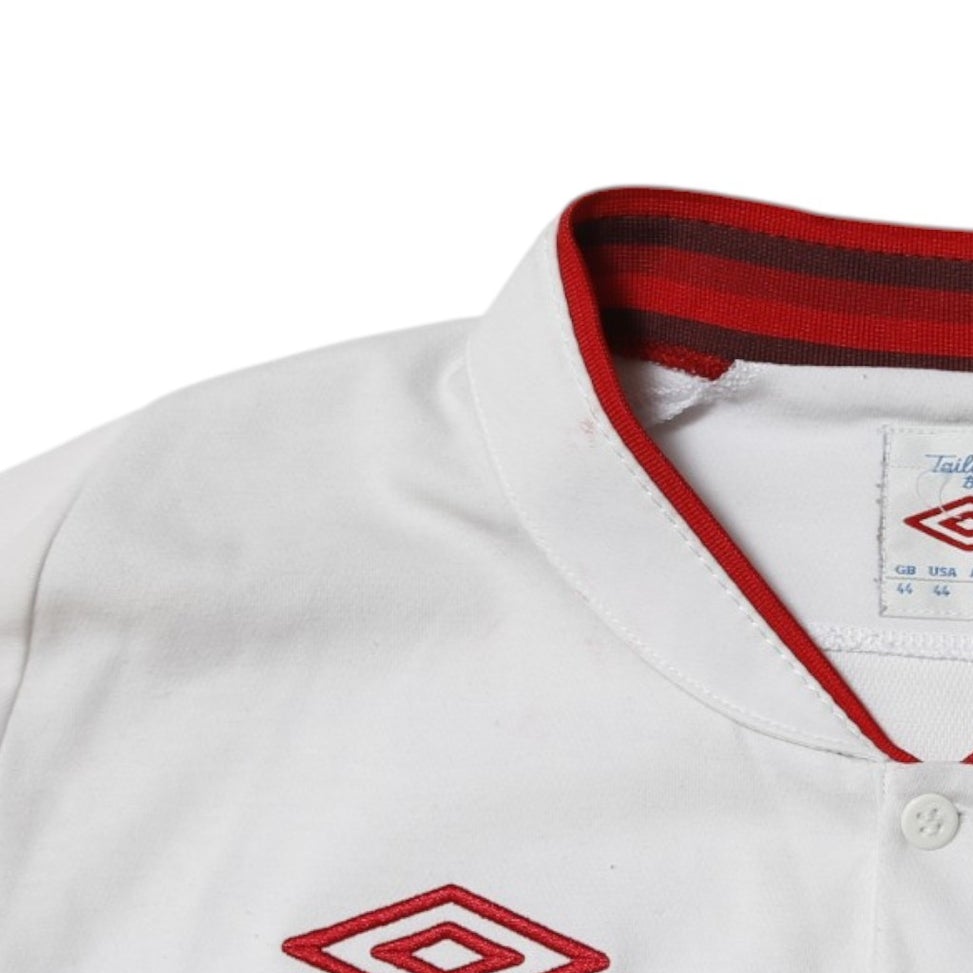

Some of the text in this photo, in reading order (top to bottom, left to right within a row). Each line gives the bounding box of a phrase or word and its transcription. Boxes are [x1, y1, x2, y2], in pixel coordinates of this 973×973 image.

[895, 564, 916, 576] GB
[928, 565, 957, 578] USA
[897, 583, 913, 594] 44
[933, 585, 951, 597] 44
